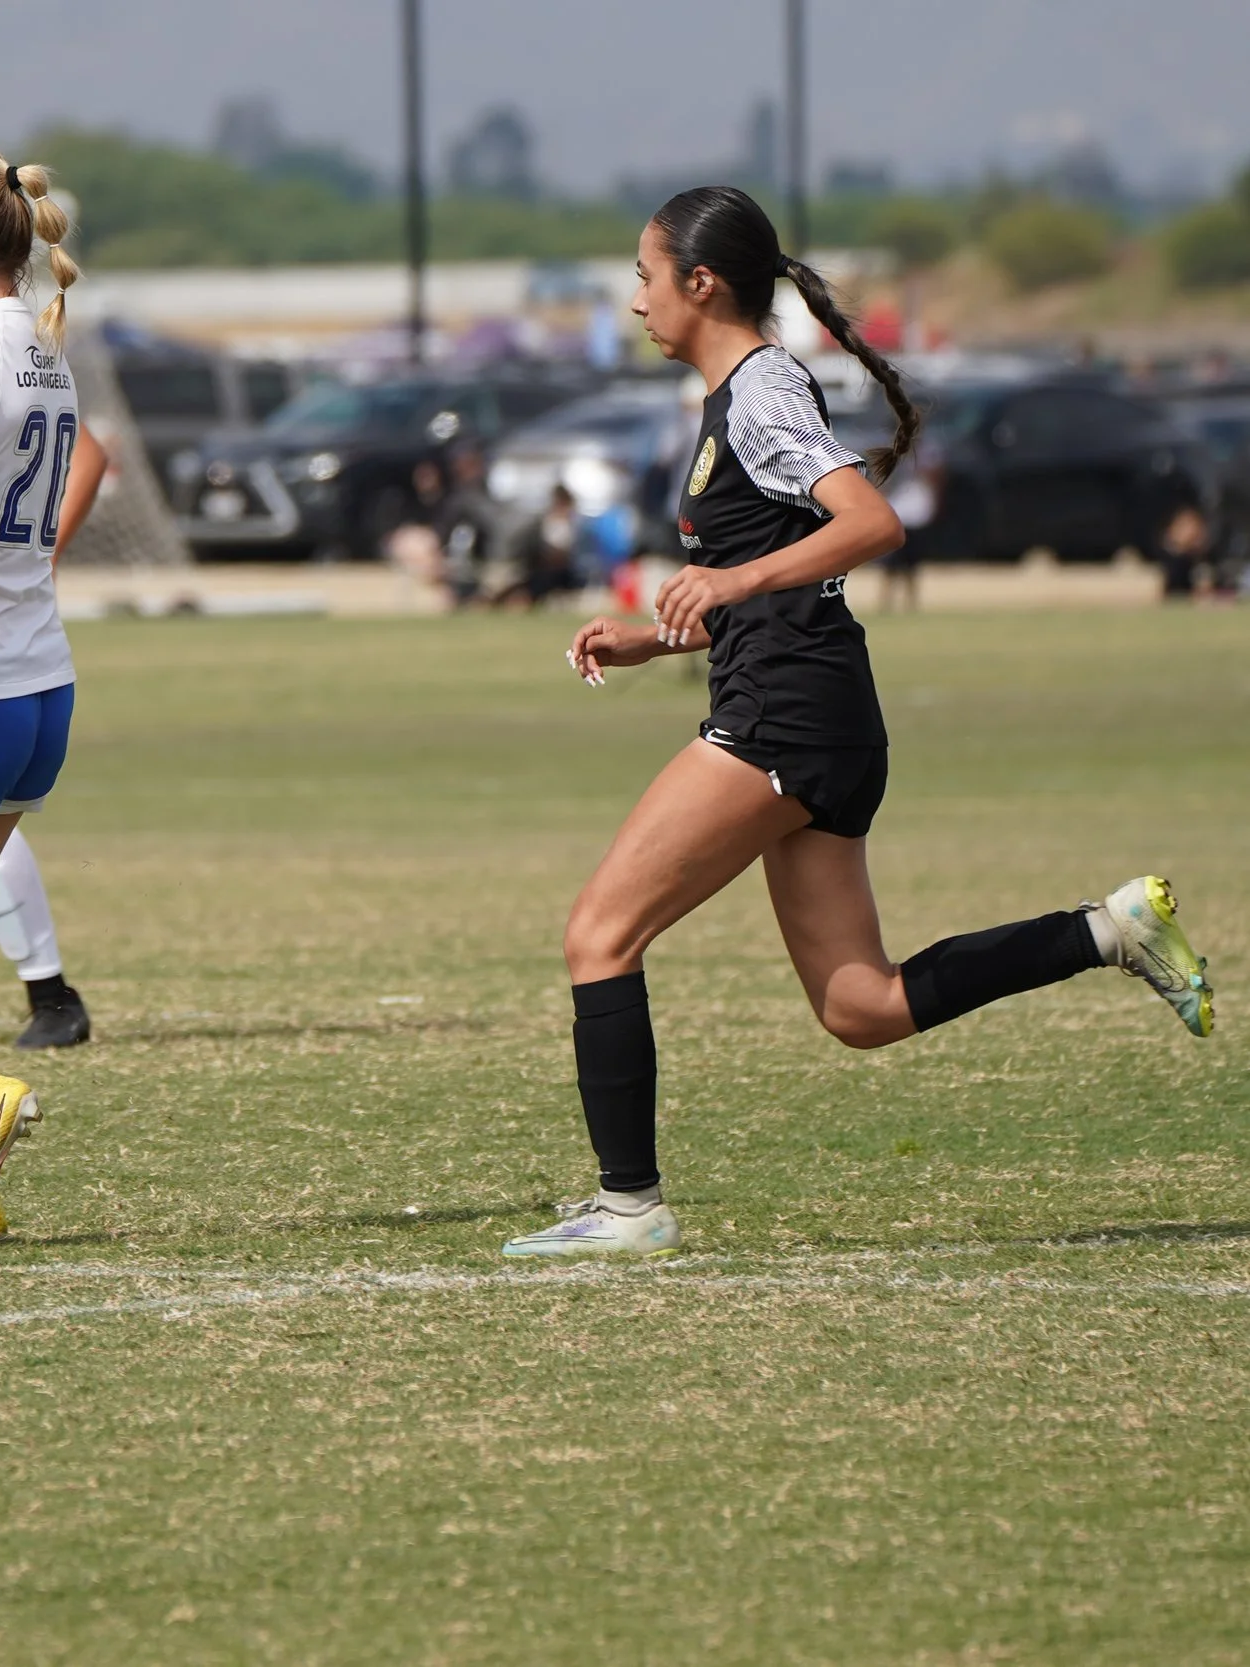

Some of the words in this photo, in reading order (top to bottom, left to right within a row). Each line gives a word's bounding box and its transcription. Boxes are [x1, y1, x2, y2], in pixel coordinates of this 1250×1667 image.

[32, 353, 55, 370] SURF
[16, 371, 39, 388] LOS
[39, 371, 71, 390] ANGELES
